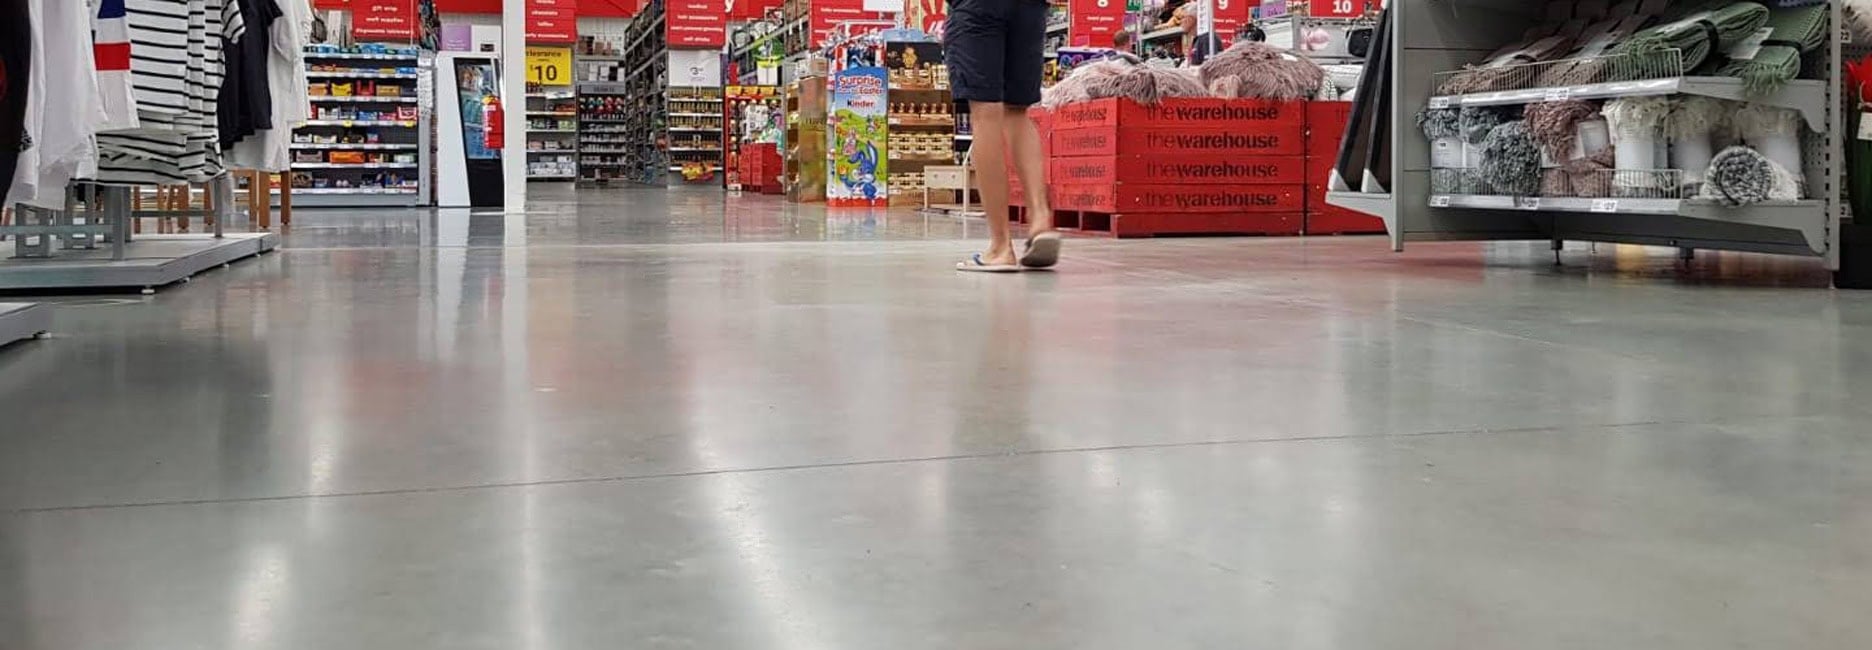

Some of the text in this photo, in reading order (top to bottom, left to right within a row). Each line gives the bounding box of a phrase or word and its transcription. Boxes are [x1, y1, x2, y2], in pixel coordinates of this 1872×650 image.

[1332, 0, 1352, 13] 10
[839, 75, 882, 87] Surprise
[847, 99, 875, 107] Kinder
